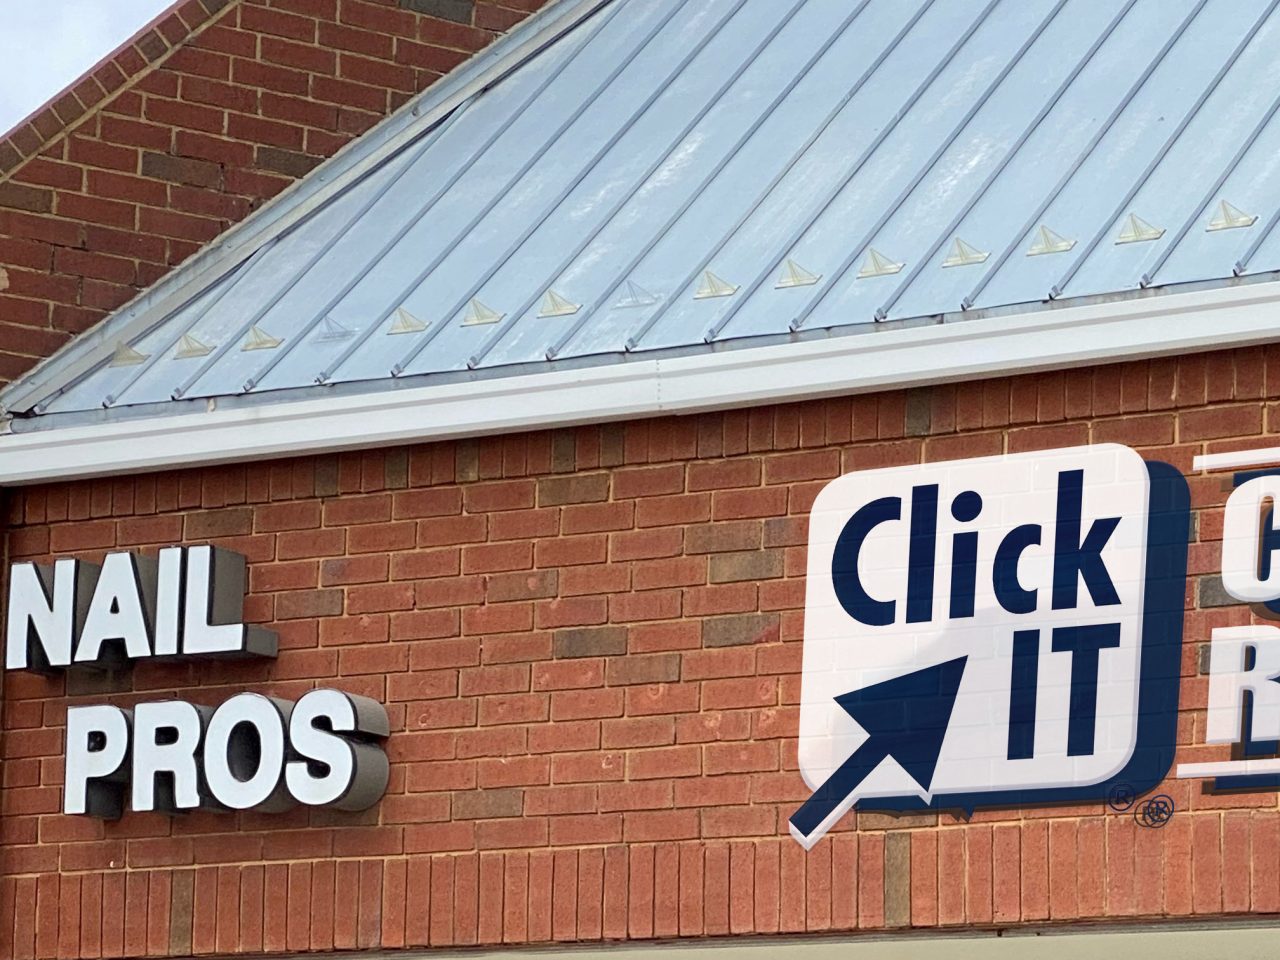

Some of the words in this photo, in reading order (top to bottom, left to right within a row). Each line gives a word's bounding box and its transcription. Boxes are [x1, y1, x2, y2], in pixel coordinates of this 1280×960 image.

[5, 544, 245, 670] NAIL
[831, 468, 1122, 627] Click
[63, 688, 357, 815] PROS
[1006, 622, 1121, 761] IT
